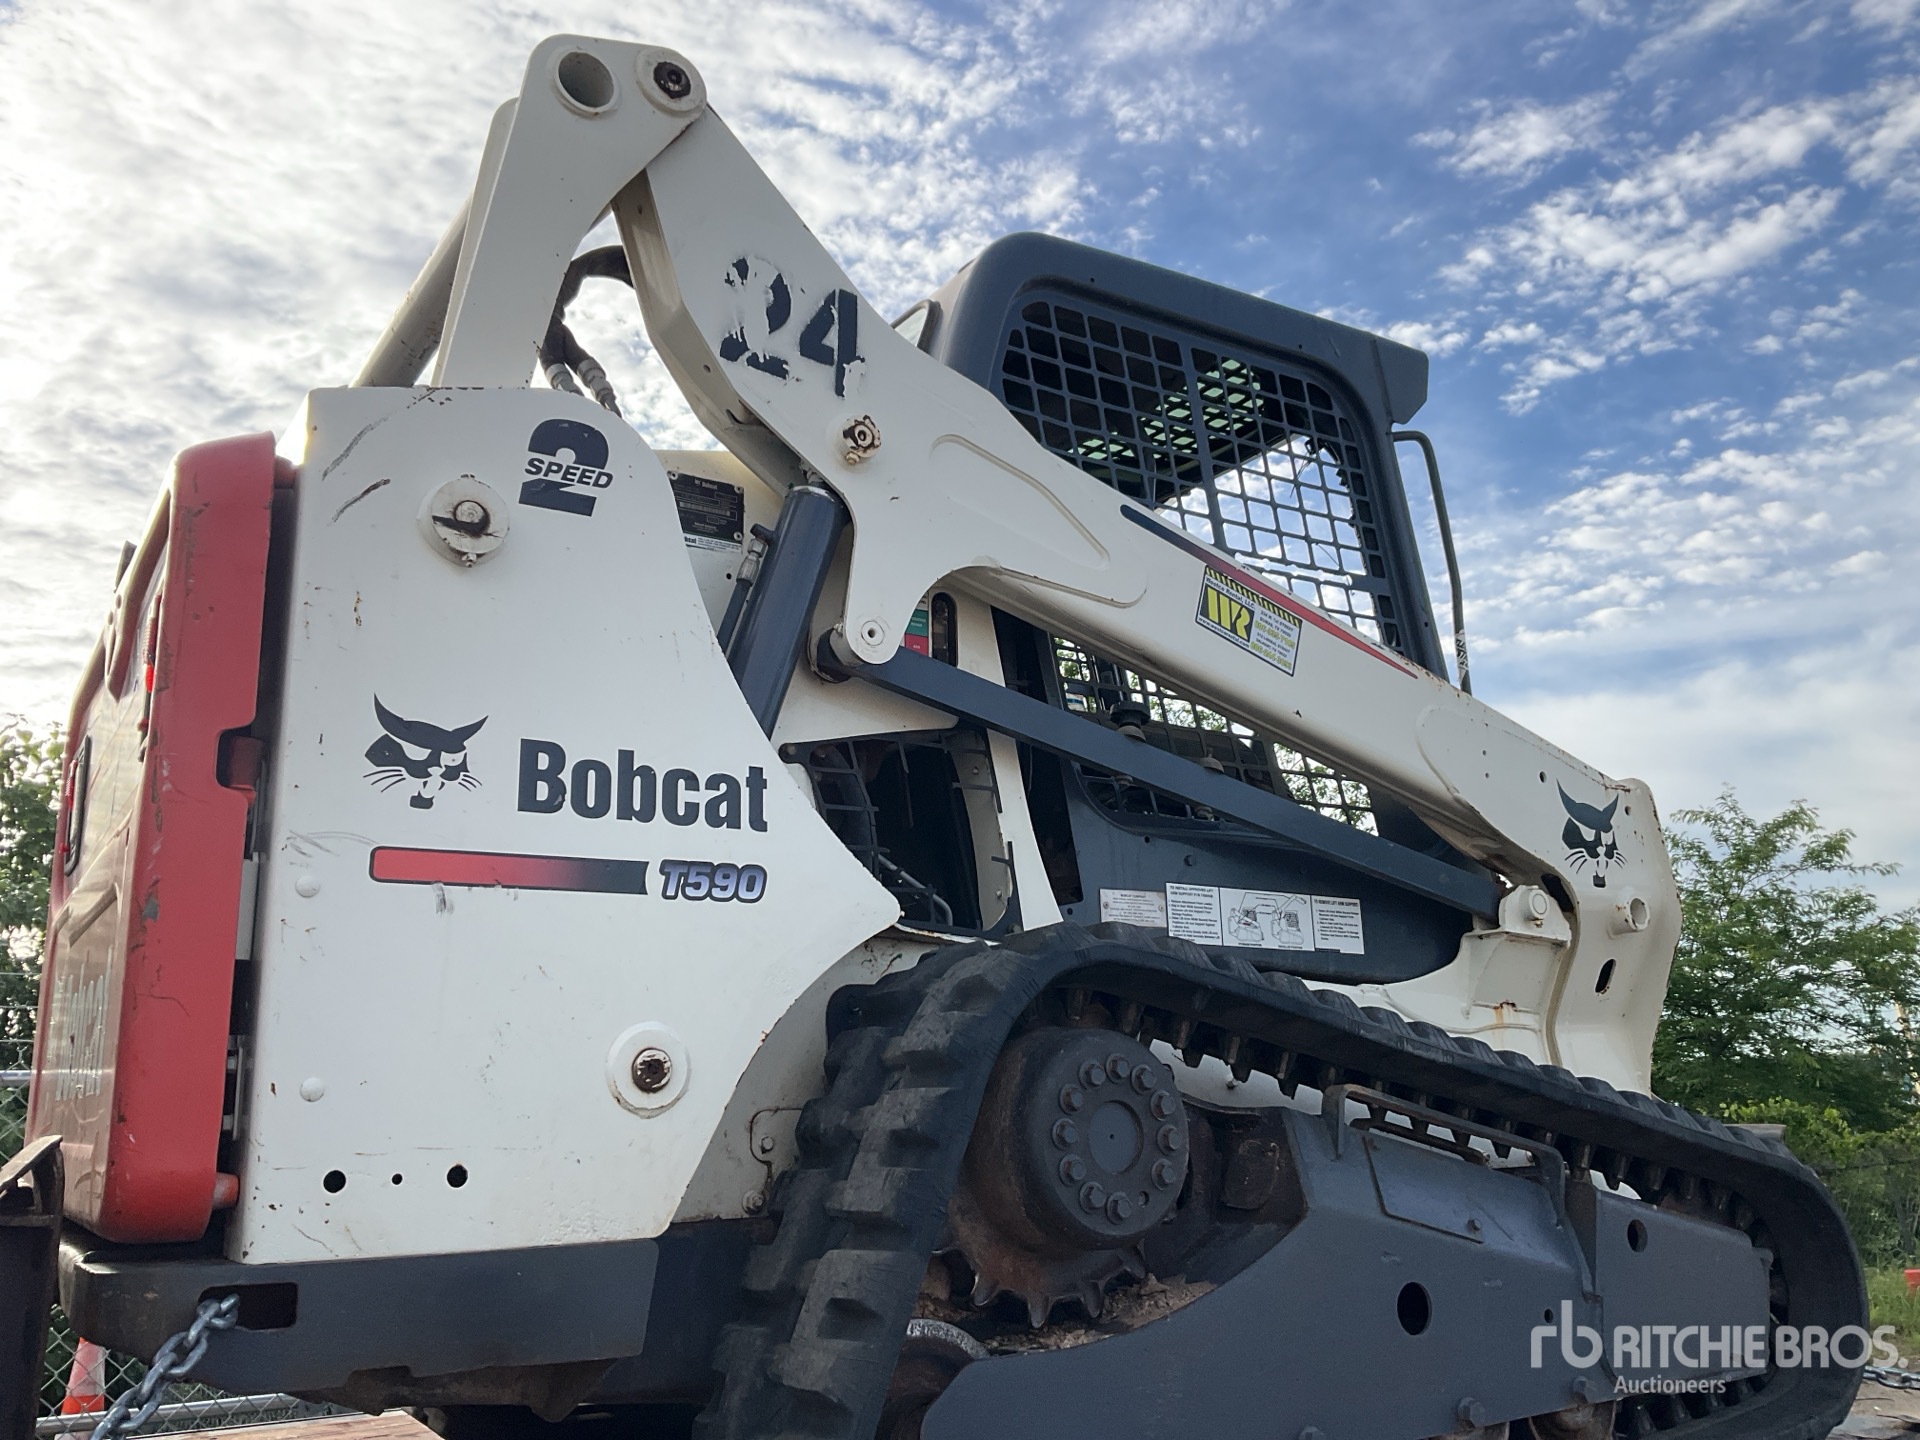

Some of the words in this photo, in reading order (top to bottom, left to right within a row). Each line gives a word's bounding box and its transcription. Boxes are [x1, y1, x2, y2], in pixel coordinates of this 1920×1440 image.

[518, 419, 609, 517] 2
[524, 457, 614, 489] SPEED
[1225, 588, 1244, 604] Rental,
[517, 738, 768, 832] Bobcat
[659, 859, 768, 903] T590
